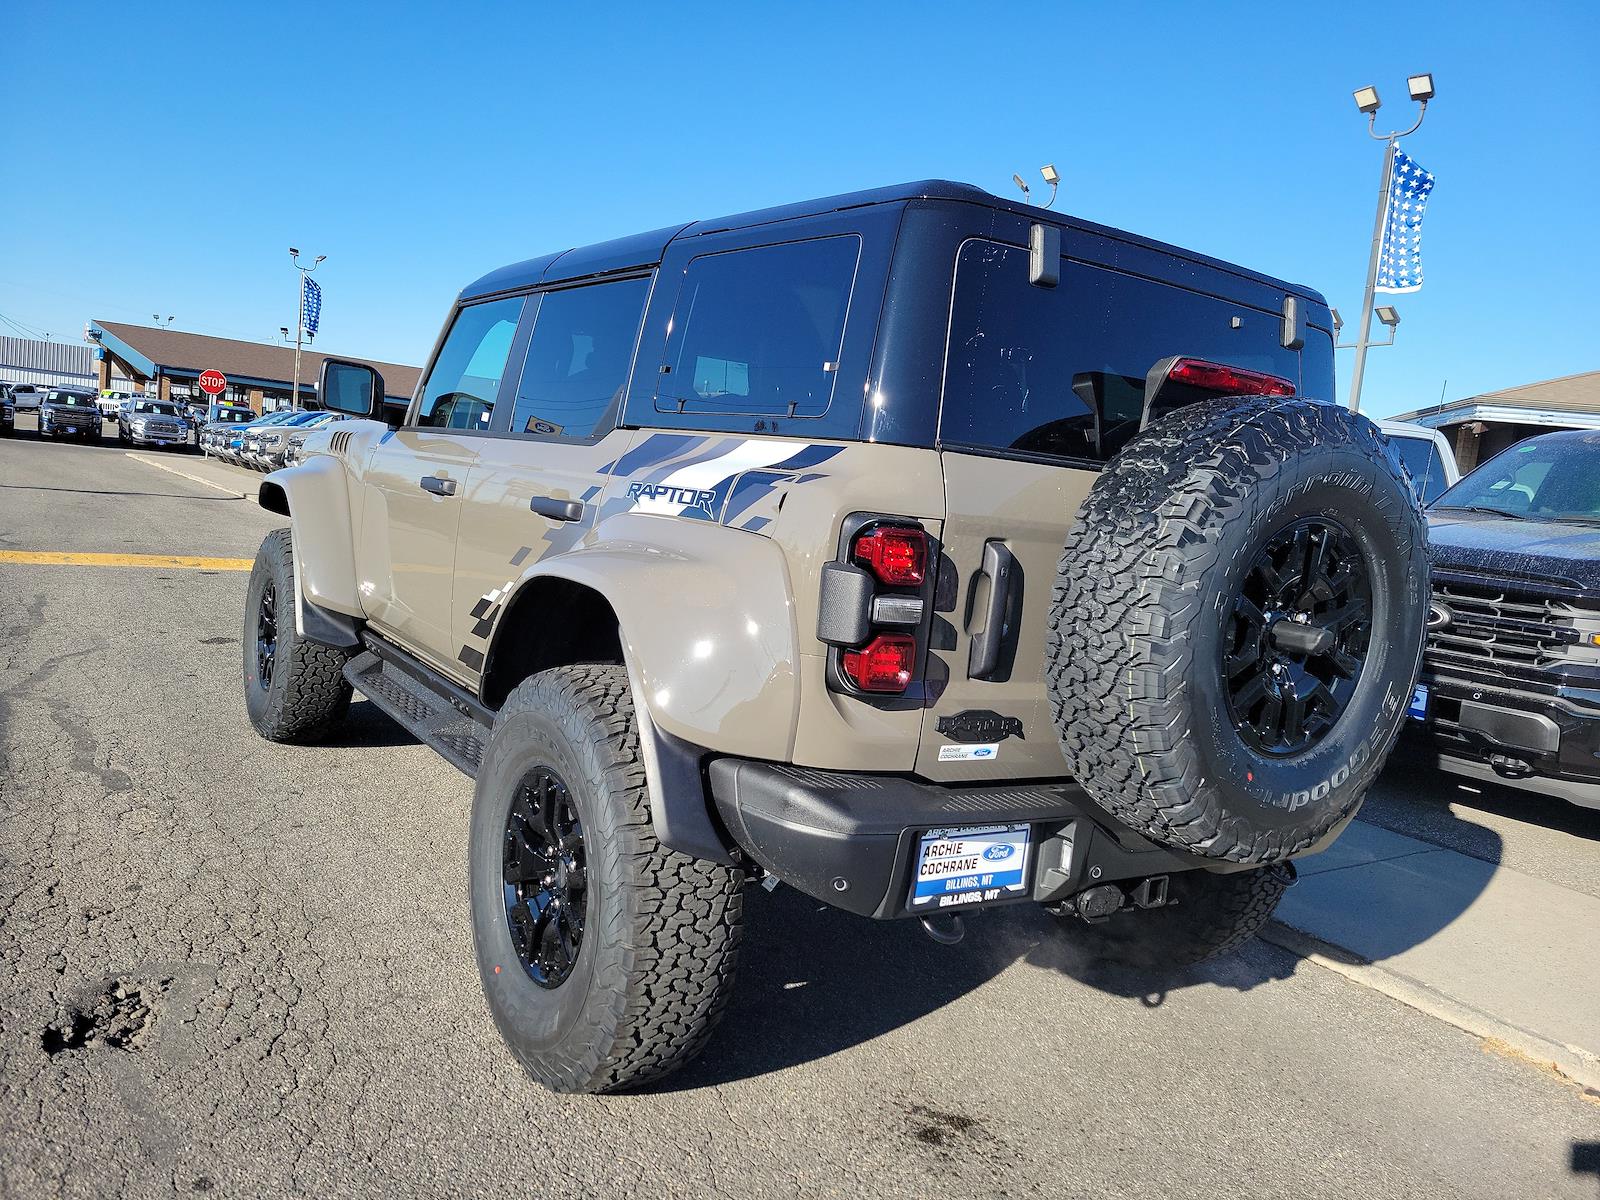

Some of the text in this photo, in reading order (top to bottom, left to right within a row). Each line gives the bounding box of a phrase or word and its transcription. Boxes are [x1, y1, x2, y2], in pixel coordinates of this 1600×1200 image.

[201, 376, 224, 387] STOP
[626, 481, 716, 520] RAPTOR
[923, 843, 1012, 860] ARCHIE Ford
[921, 858, 978, 875] COCHRANE
[945, 874, 994, 891] BILLINGS, MT
[939, 889, 1001, 907] BILLINGS, MT
